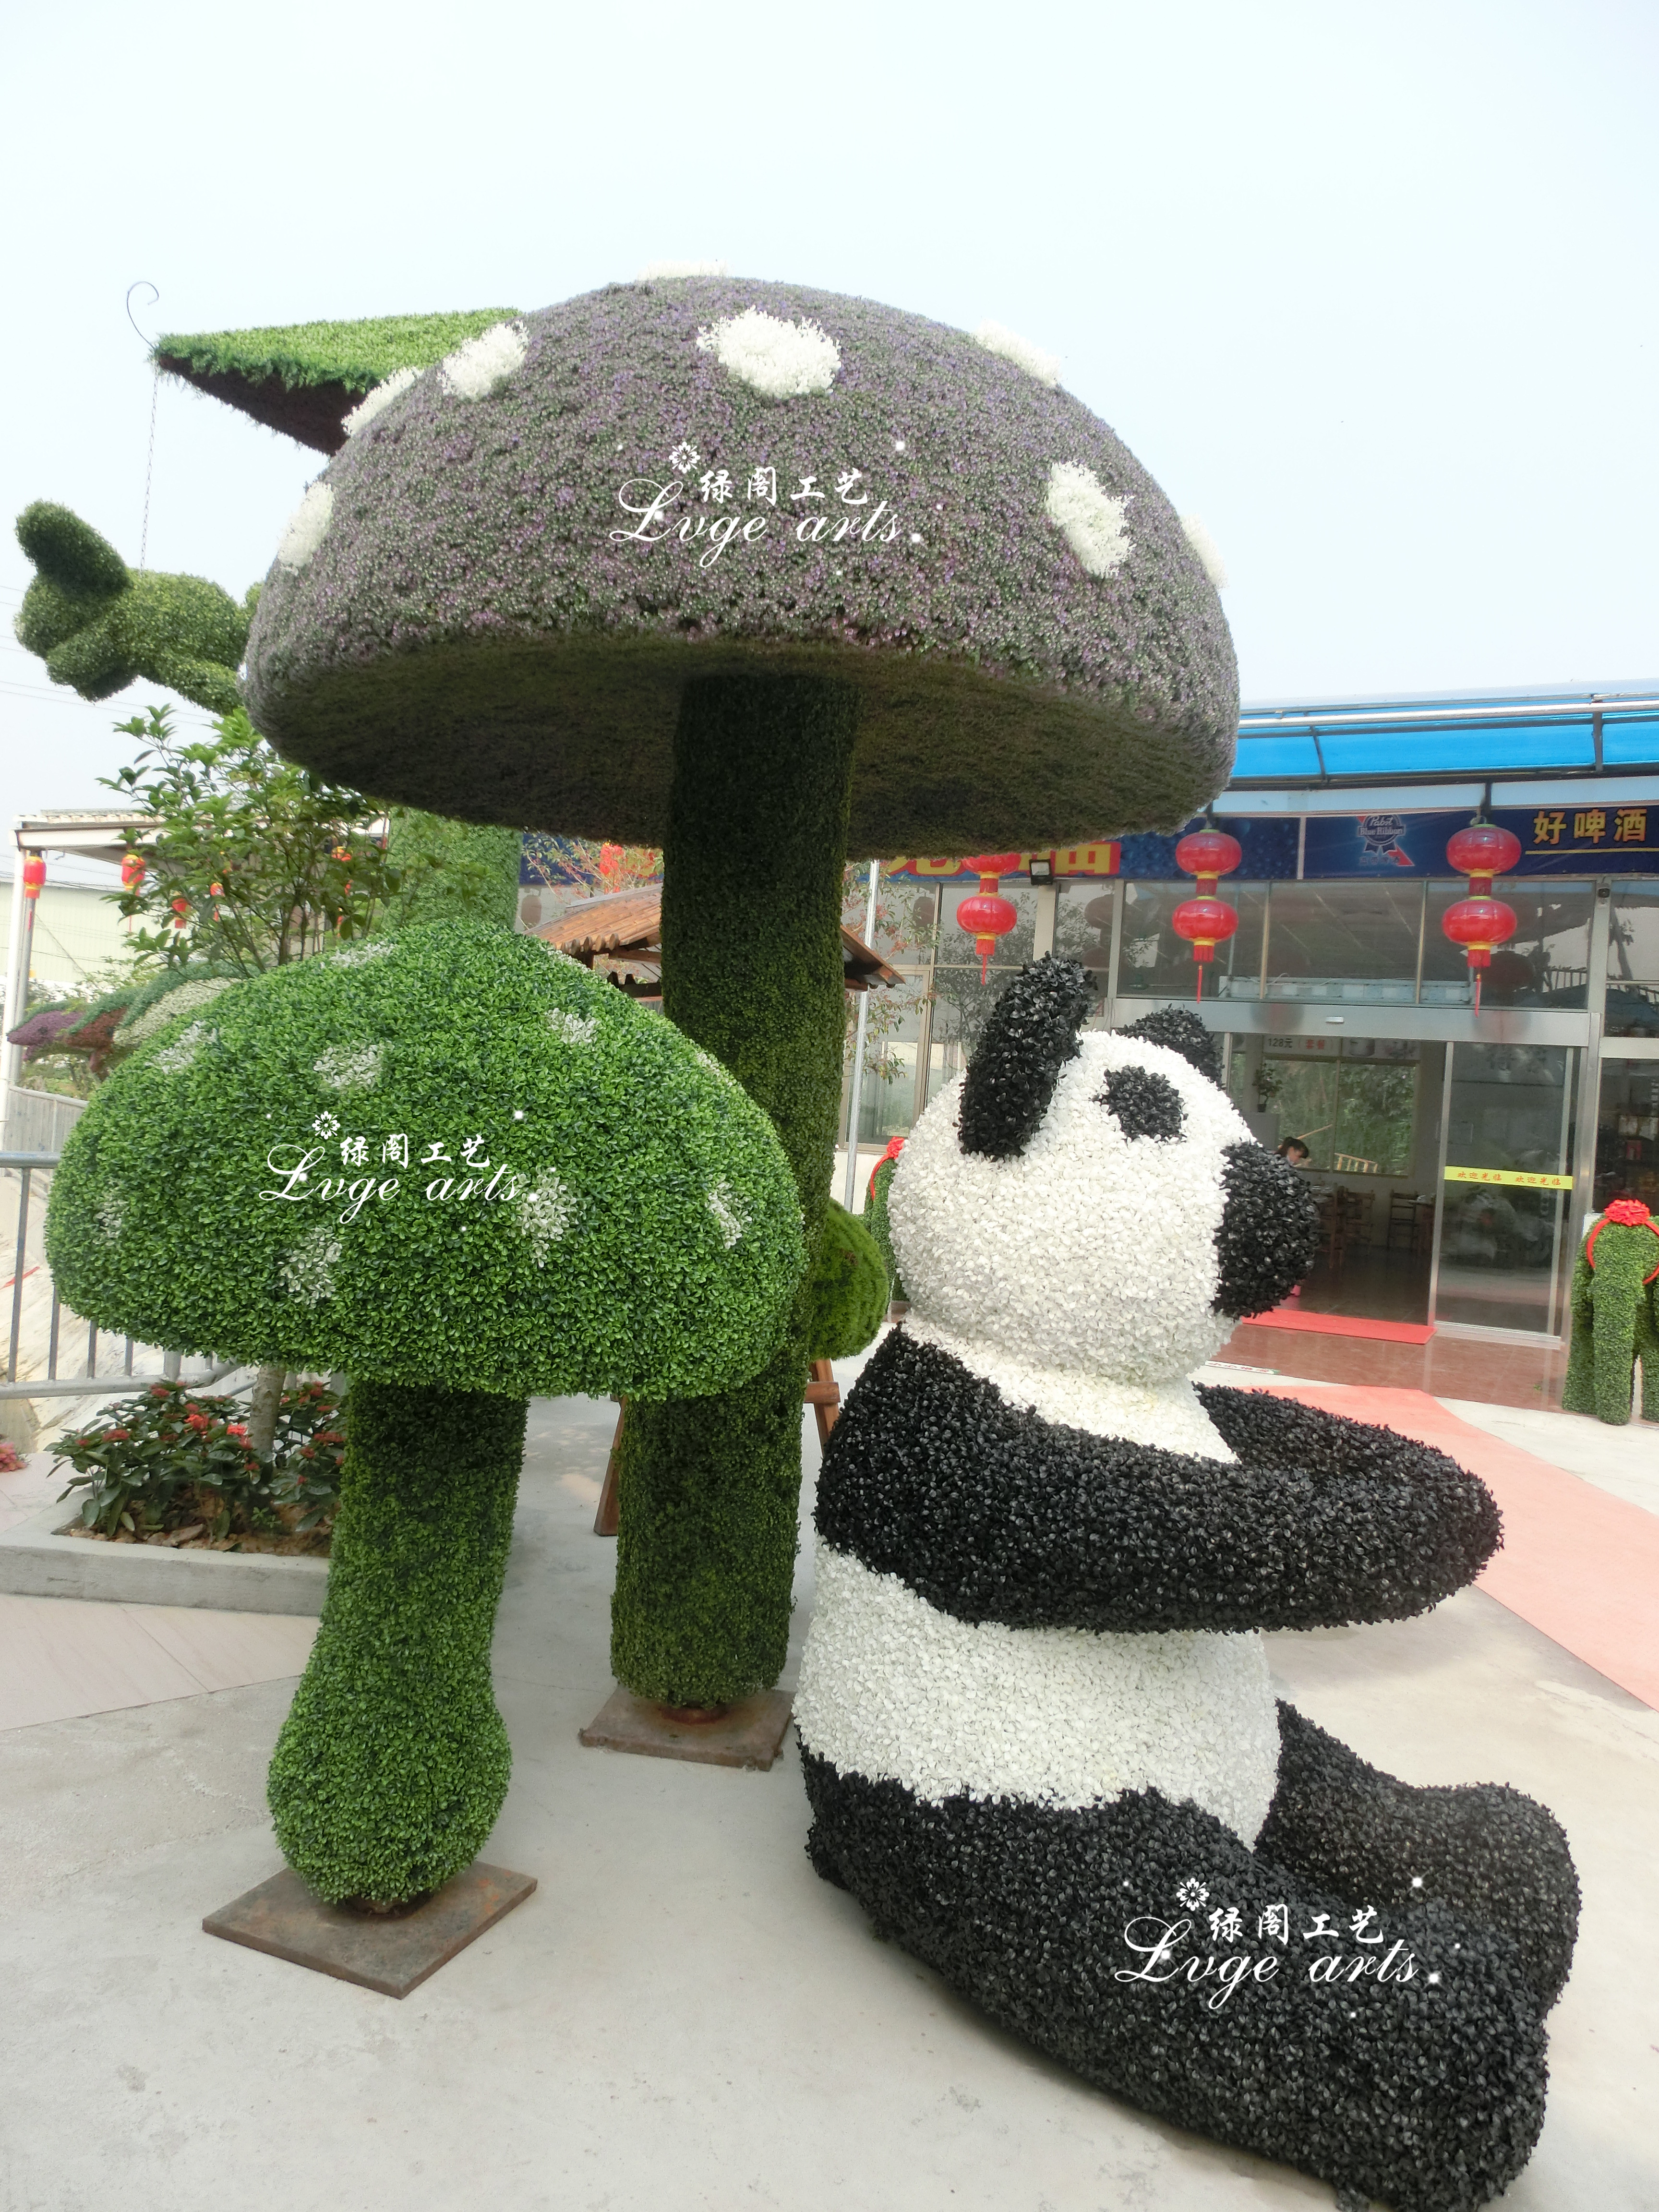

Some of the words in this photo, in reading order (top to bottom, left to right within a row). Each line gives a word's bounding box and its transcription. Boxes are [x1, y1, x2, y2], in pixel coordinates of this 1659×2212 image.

[1370, 816, 1393, 826] Pabst
[1533, 808, 1647, 844] 好啤酒
[1360, 827, 1376, 835] Blue
[1377, 827, 1403, 835] Ribbon
[1268, 1038, 1293, 1048] 128元
[1457, 1171, 1502, 1181] 欢迎光临
[1515, 1175, 1562, 1186] 欢迎光临
